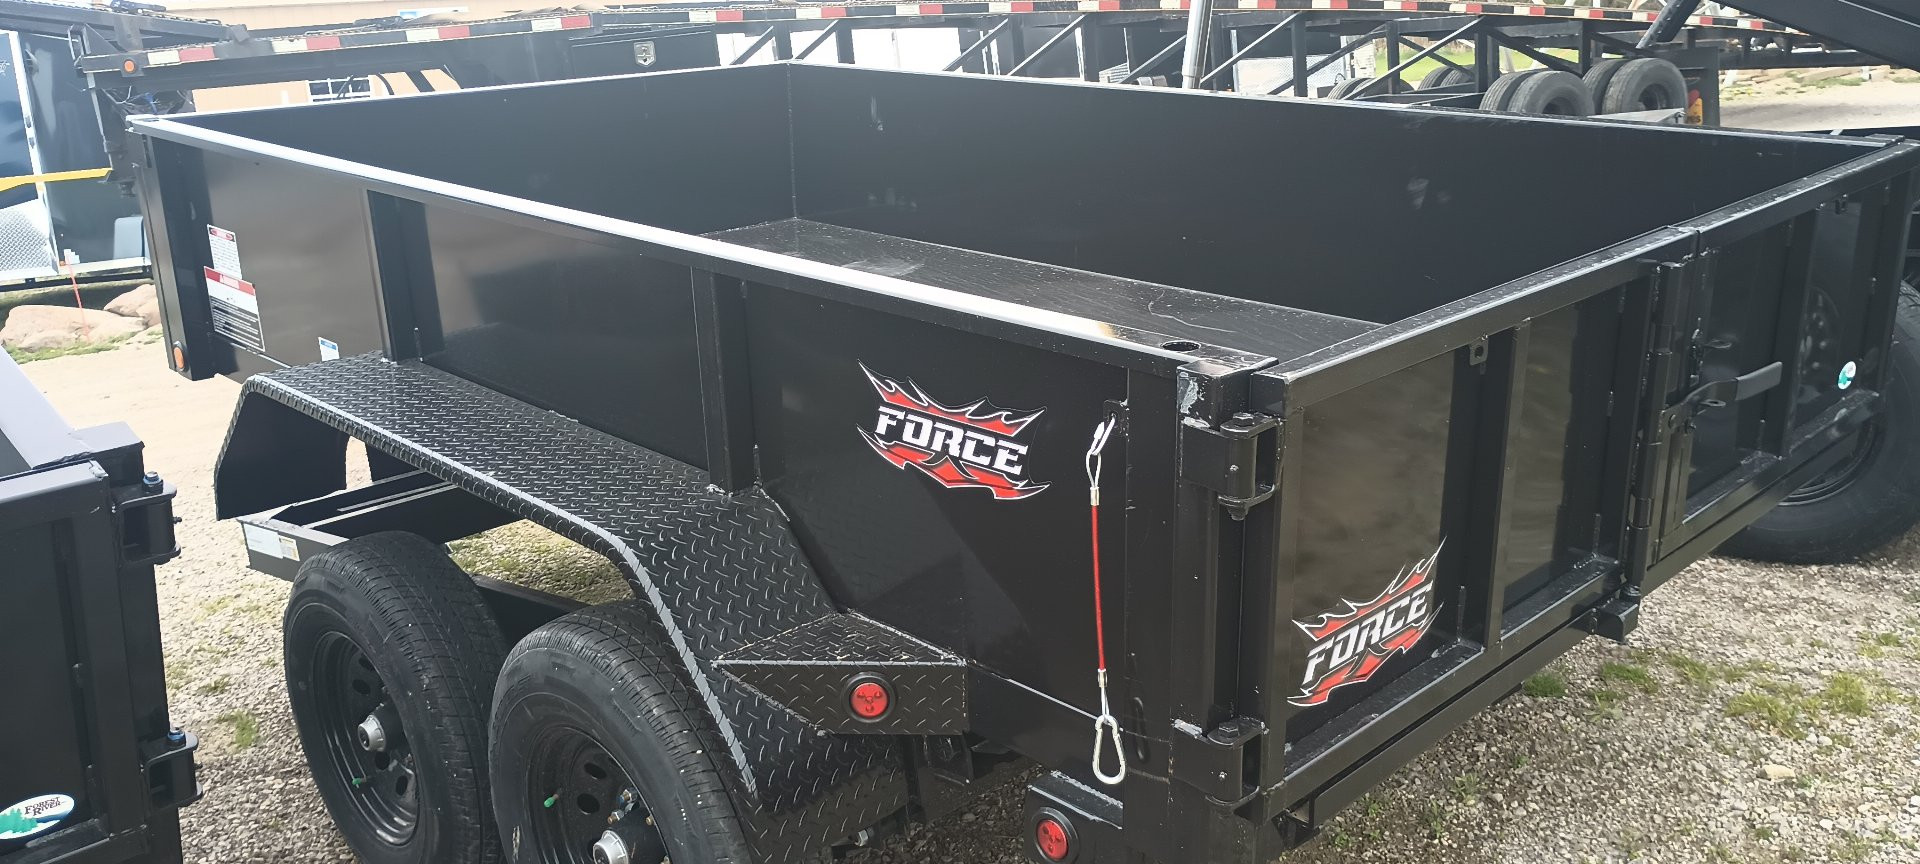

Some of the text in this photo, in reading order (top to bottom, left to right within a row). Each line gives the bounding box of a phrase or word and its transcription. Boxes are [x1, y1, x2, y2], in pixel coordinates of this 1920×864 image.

[874, 405, 1029, 475] FORCE
[1302, 579, 1434, 686] FORCE
[33, 801, 61, 816] RIVER
